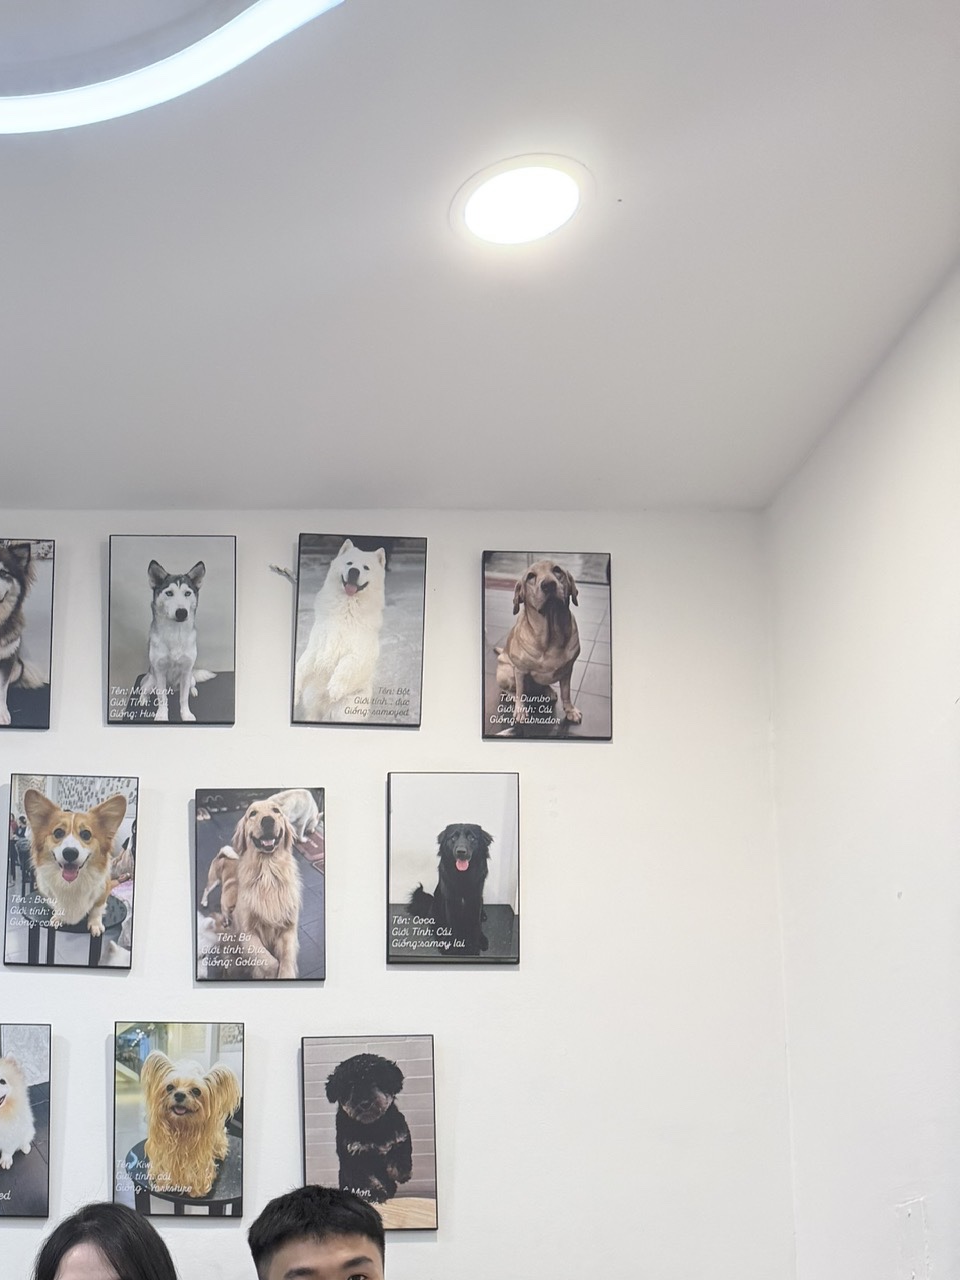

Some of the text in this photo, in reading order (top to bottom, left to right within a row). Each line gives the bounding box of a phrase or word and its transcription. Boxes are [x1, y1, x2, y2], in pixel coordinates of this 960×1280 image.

[110, 686, 128, 695] Tên:
[150, 686, 174, 695] Xanh
[372, 697, 387, 705] tính
[520, 694, 550, 703] Dumbo
[538, 706, 552, 714] Cái
[110, 709, 138, 720] Giống:
[490, 715, 560, 726] Giống: Labrador
[11, 895, 26, 903] Tên
[29, 906, 50, 915] tính:
[392, 916, 435, 924] Tên: Coca
[392, 928, 452, 936] Giới Tính: Cái
[217, 933, 236, 941] Tên:
[453, 939, 465, 947] lai
[223, 945, 244, 954] tính:
[202, 956, 268, 968] Giống: Golden
